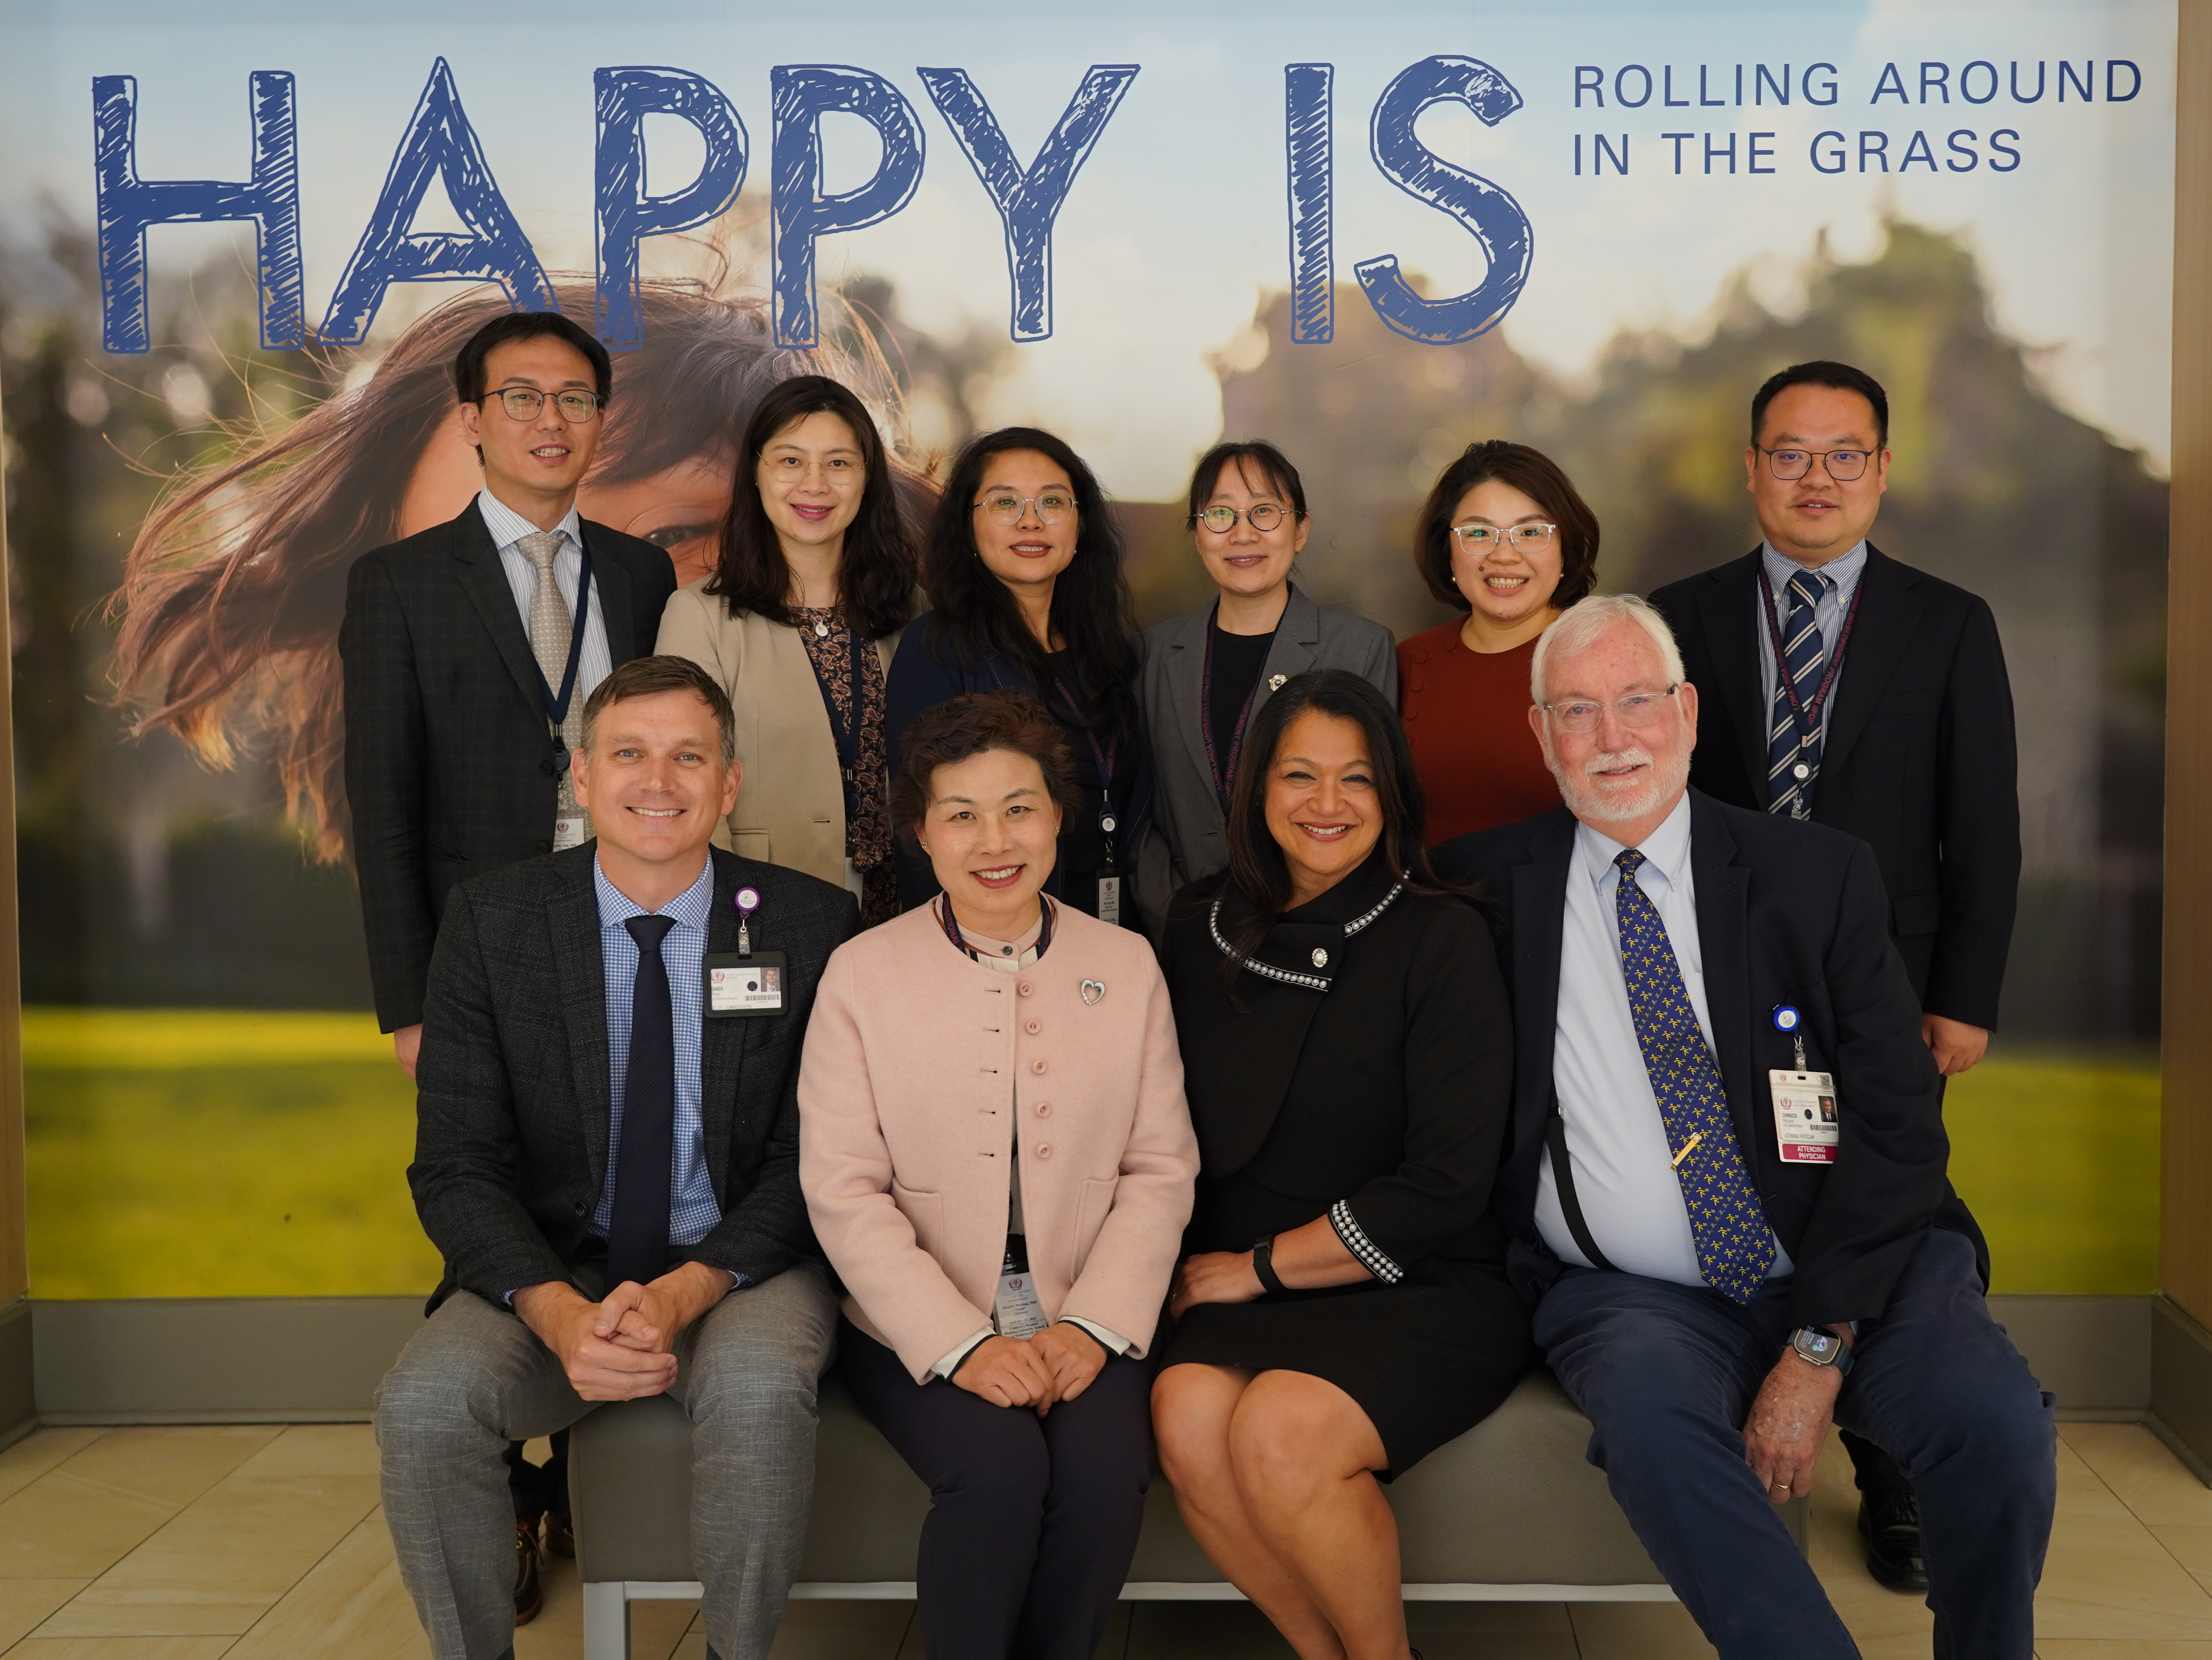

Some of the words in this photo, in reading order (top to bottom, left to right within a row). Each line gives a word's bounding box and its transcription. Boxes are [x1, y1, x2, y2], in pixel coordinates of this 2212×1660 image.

[1575, 64, 1837, 108] ROLLING
[1871, 61, 2140, 104] AROUND
[1575, 134, 1627, 175] IN
[1662, 133, 1774, 174] THE
[1811, 130, 2019, 173] GRASS
[92, 56, 1140, 353] HAPPY
[1285, 56, 1533, 345] IS
[1832, 612, 1855, 666] DEVELOPEMENT
[1780, 667, 1793, 689] LINDA
[1815, 667, 1835, 705] PROGRAM
[1788, 689, 1800, 710] LOMA
[1201, 703, 1212, 743] UNIVERSITY
[1205, 744, 1216, 767] LINDA
[1226, 741, 1240, 780] PROGRAM
[1212, 767, 1221, 789] LOMA
